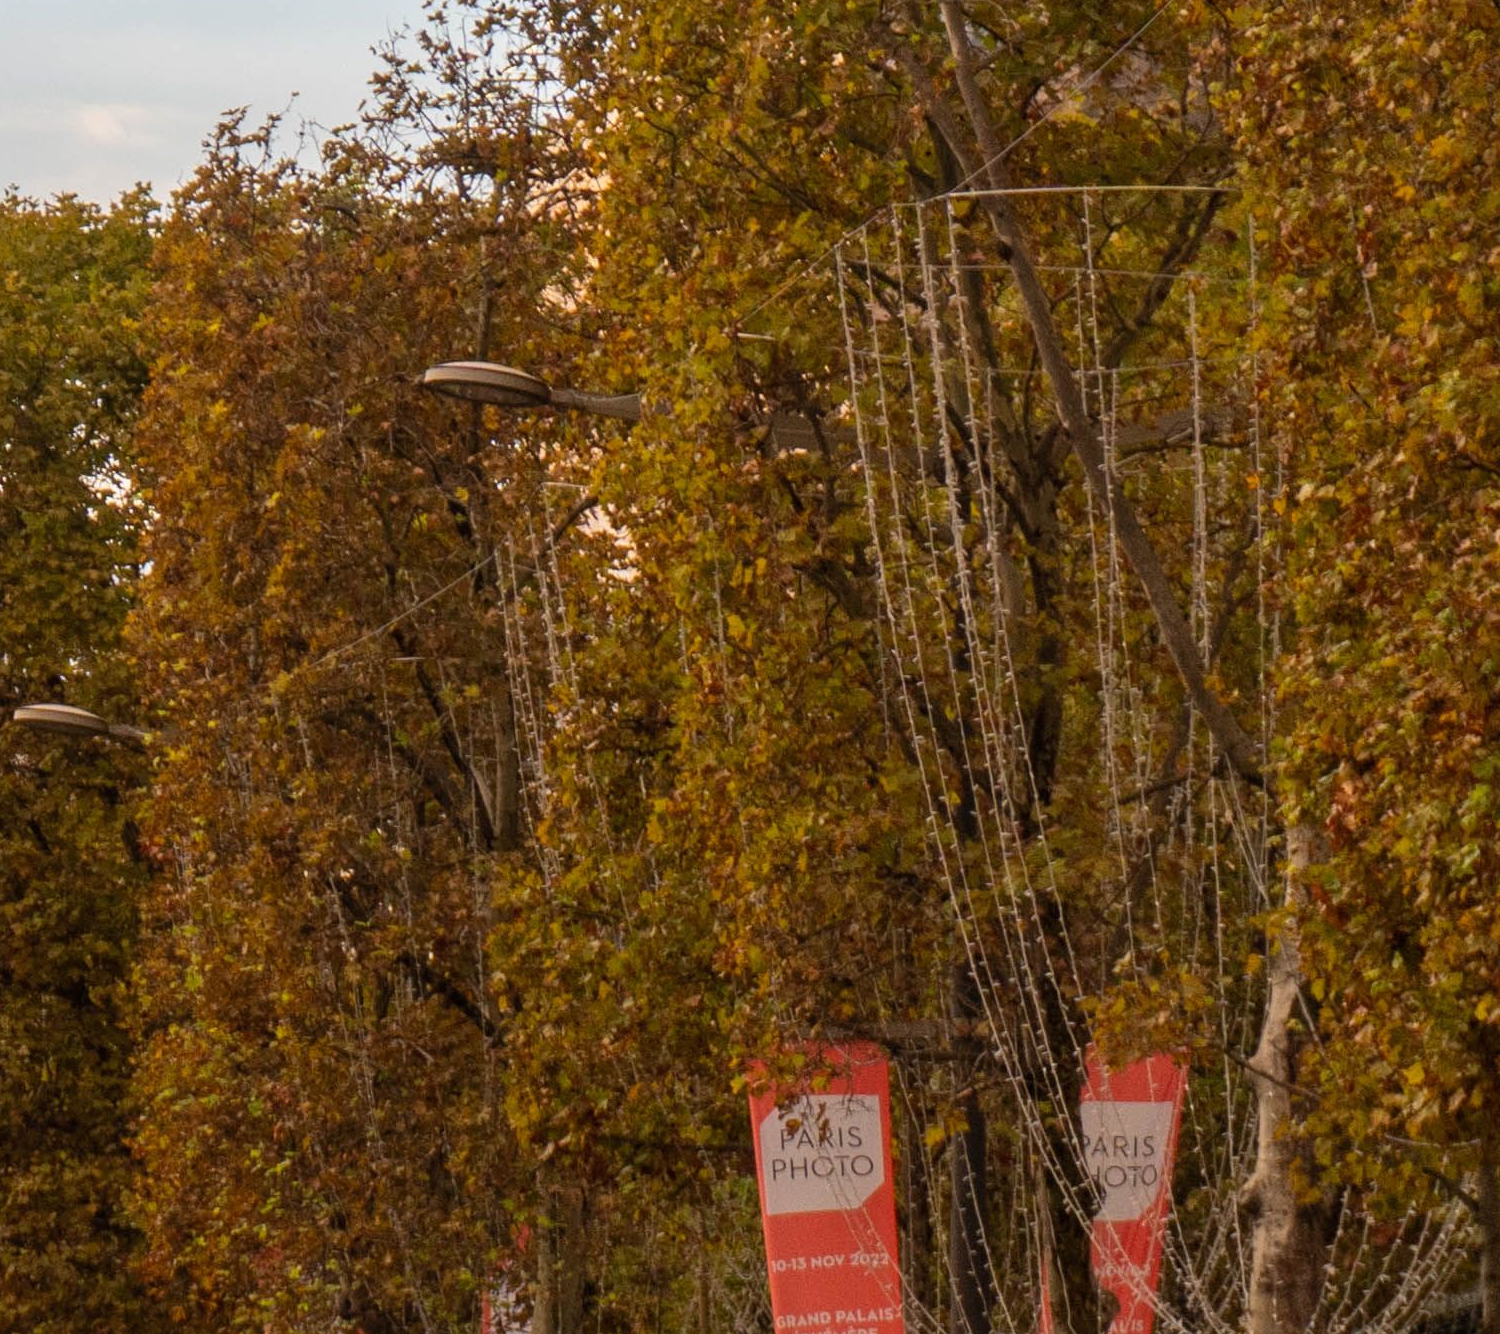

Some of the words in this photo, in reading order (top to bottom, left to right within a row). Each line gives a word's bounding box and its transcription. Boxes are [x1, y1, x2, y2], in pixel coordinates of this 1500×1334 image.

[779, 1126, 863, 1151] PARIS
[771, 1154, 875, 1180] PHOTO
[771, 1257, 807, 1273] 10-13
[810, 1254, 845, 1269] NOV
[849, 1250, 890, 1266] 2022
[776, 1311, 831, 1329] GRAND
[835, 1307, 894, 1324] PALAIS
